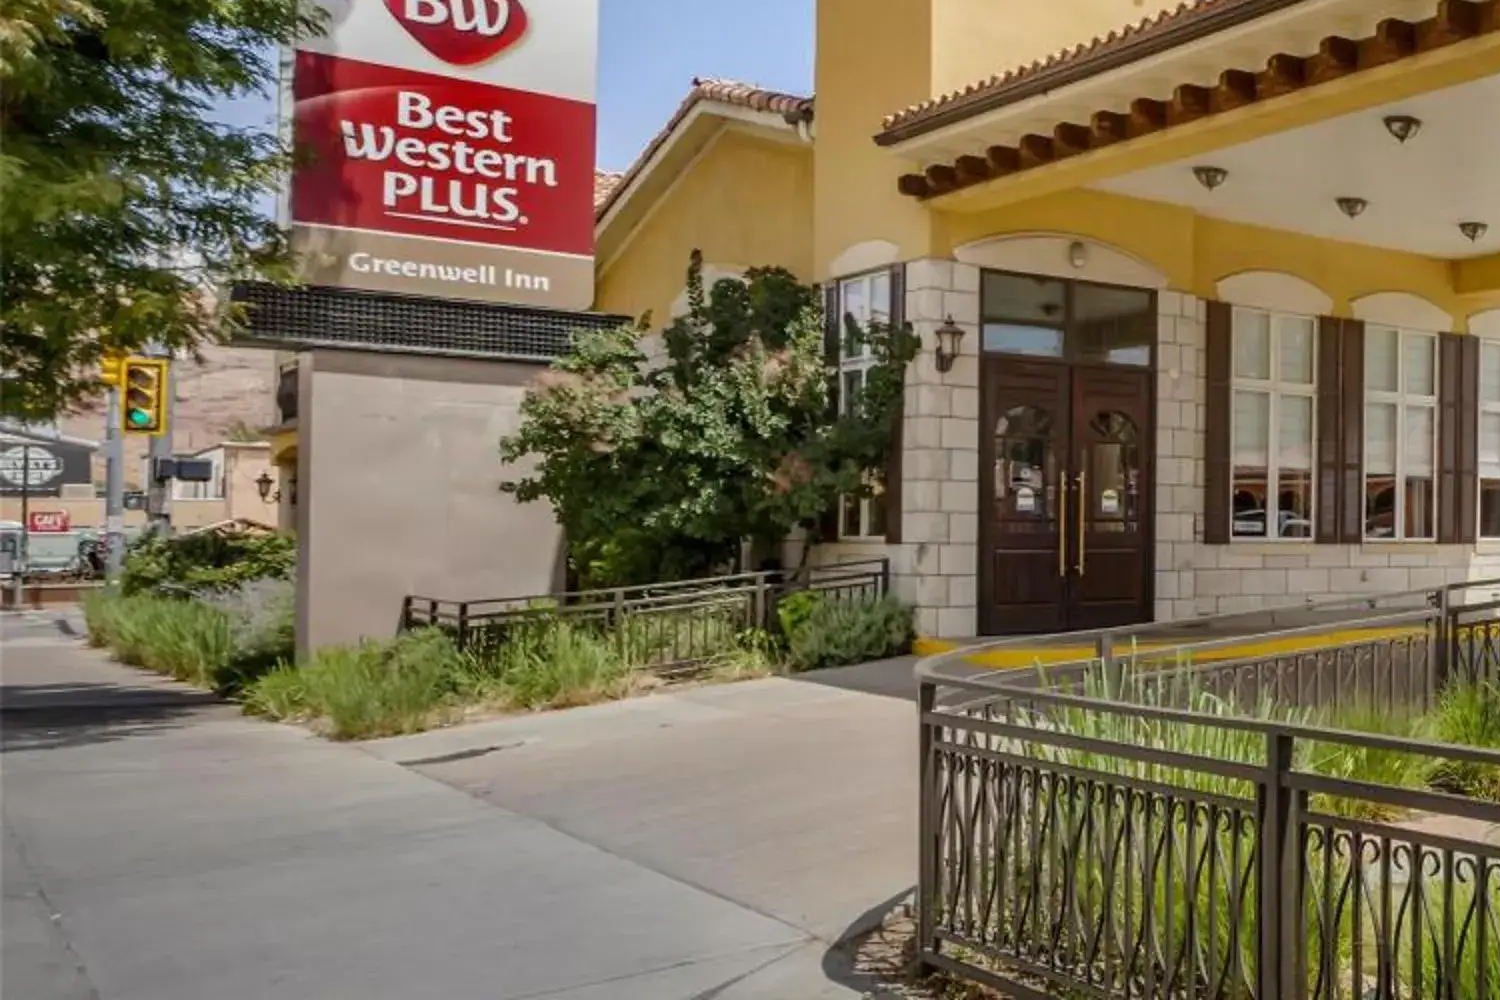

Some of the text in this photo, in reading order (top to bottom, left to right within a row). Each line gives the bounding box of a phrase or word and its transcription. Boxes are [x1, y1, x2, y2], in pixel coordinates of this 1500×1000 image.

[397, 90, 513, 143] Best
[340, 119, 558, 187] Western
[349, 252, 550, 292] Greenwell Inn
